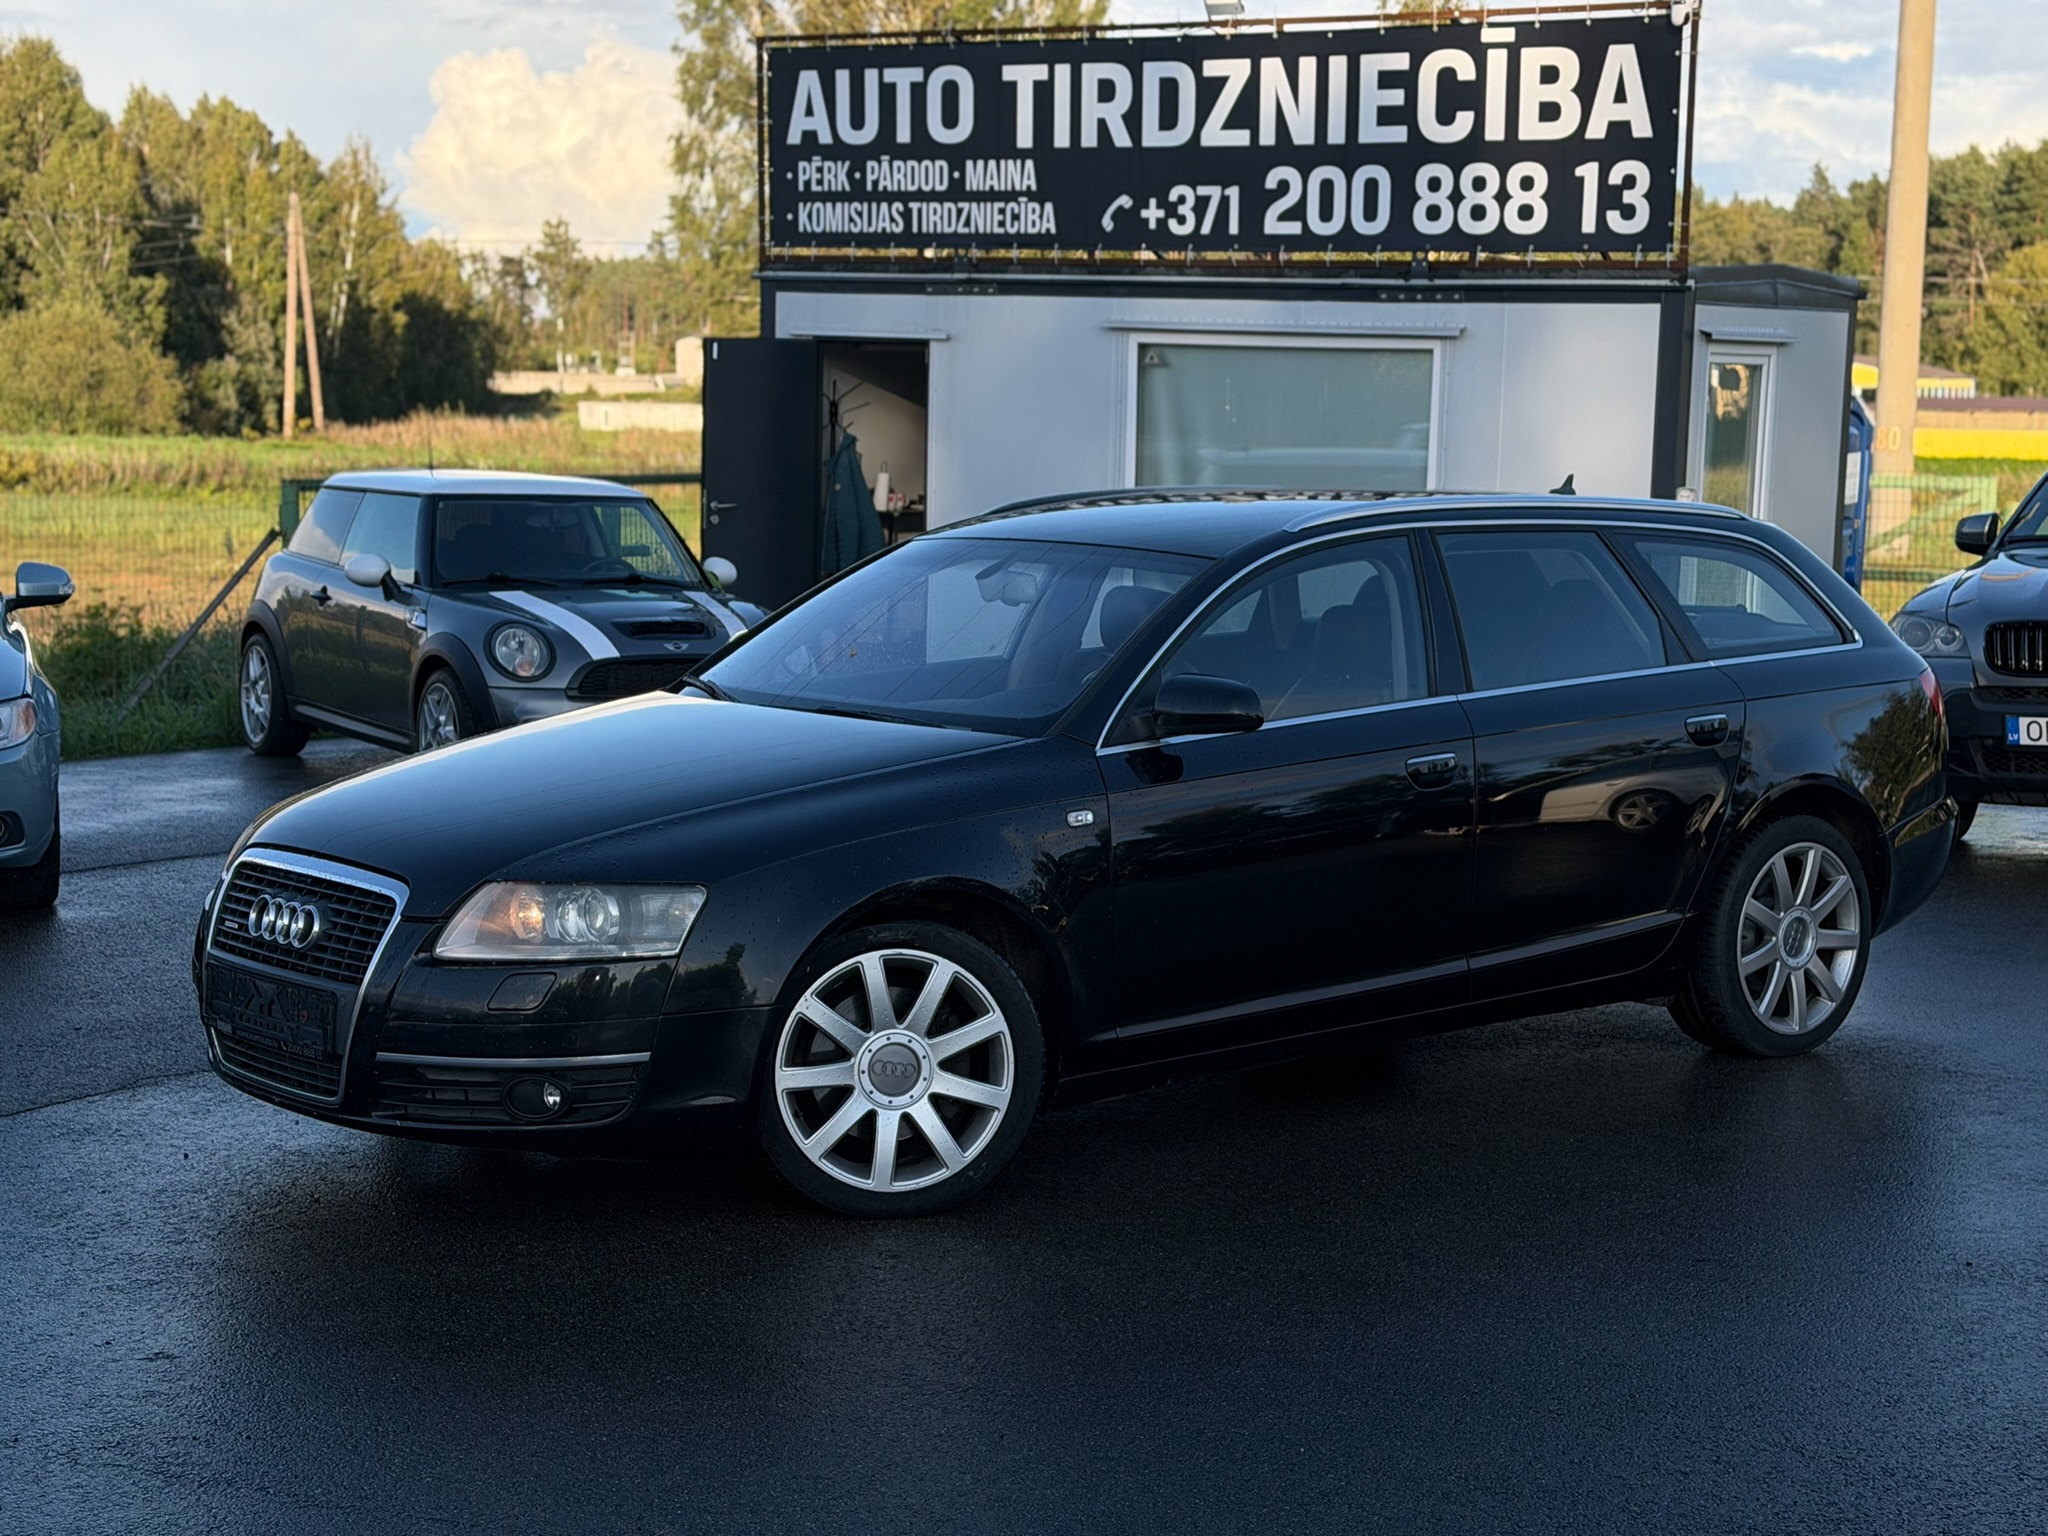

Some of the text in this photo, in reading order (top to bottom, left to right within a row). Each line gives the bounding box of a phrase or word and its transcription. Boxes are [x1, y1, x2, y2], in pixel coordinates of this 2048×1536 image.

[786, 27, 1654, 150] AUTO TIRDZNIECĪBA
[797, 154, 1037, 192] PĒRK PĀRDOD MAINA
[798, 196, 1057, 235] KOMISIJAS TIRDZNIECĪBA
[1140, 159, 1651, 236] +371 200 888 13
[2008, 732, 2019, 741] LV
[2026, 719, 2048, 742] O
